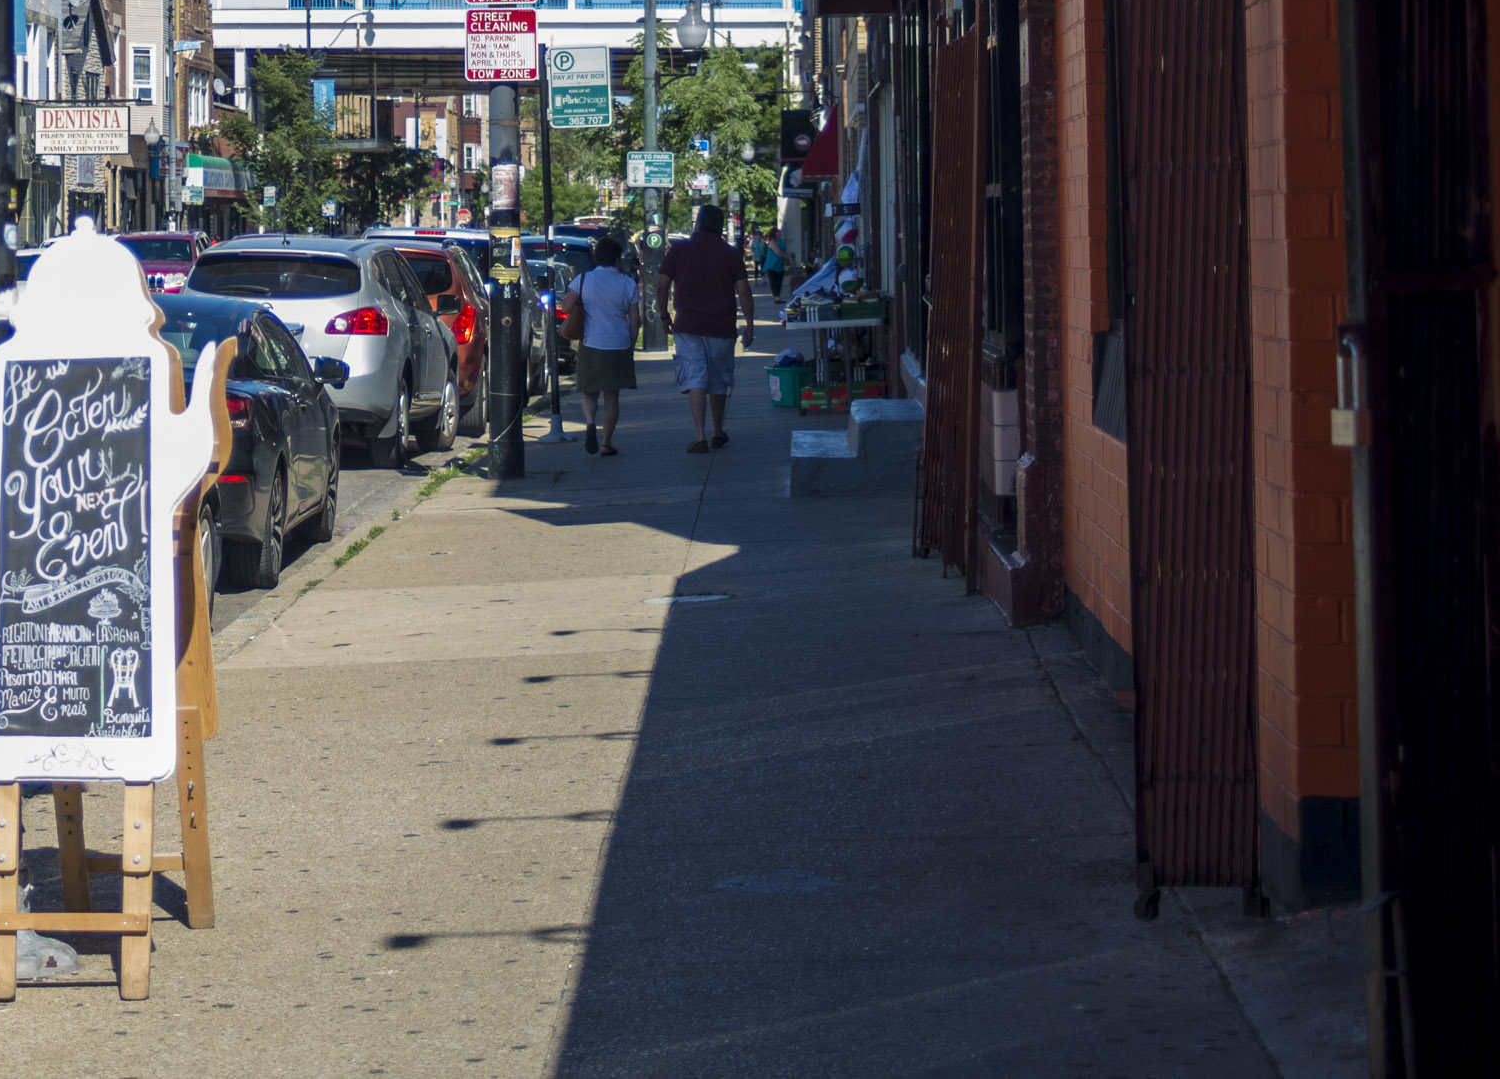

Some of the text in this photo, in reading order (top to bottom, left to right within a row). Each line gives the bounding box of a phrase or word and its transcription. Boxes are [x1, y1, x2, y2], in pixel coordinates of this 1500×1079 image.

[471, 11, 512, 22] STREET
[470, 21, 528, 32] CLEANING
[485, 34, 516, 42] PARKING
[471, 50, 521, 59] MON & THURS
[470, 69, 531, 79] TOW ZONE
[562, 97, 606, 105] ParkChicago
[43, 109, 121, 129] DENTISTA
[568, 117, 585, 125] 362
[587, 116, 604, 124] 707
[45, 359, 70, 380] us
[24, 367, 127, 467] Cater
[4, 449, 106, 539] Your
[74, 488, 119, 513] NEXT
[96, 623, 140, 643] LASAGNA
[18, 658, 56, 671] LINGUINE
[62, 687, 90, 701] MUITO
